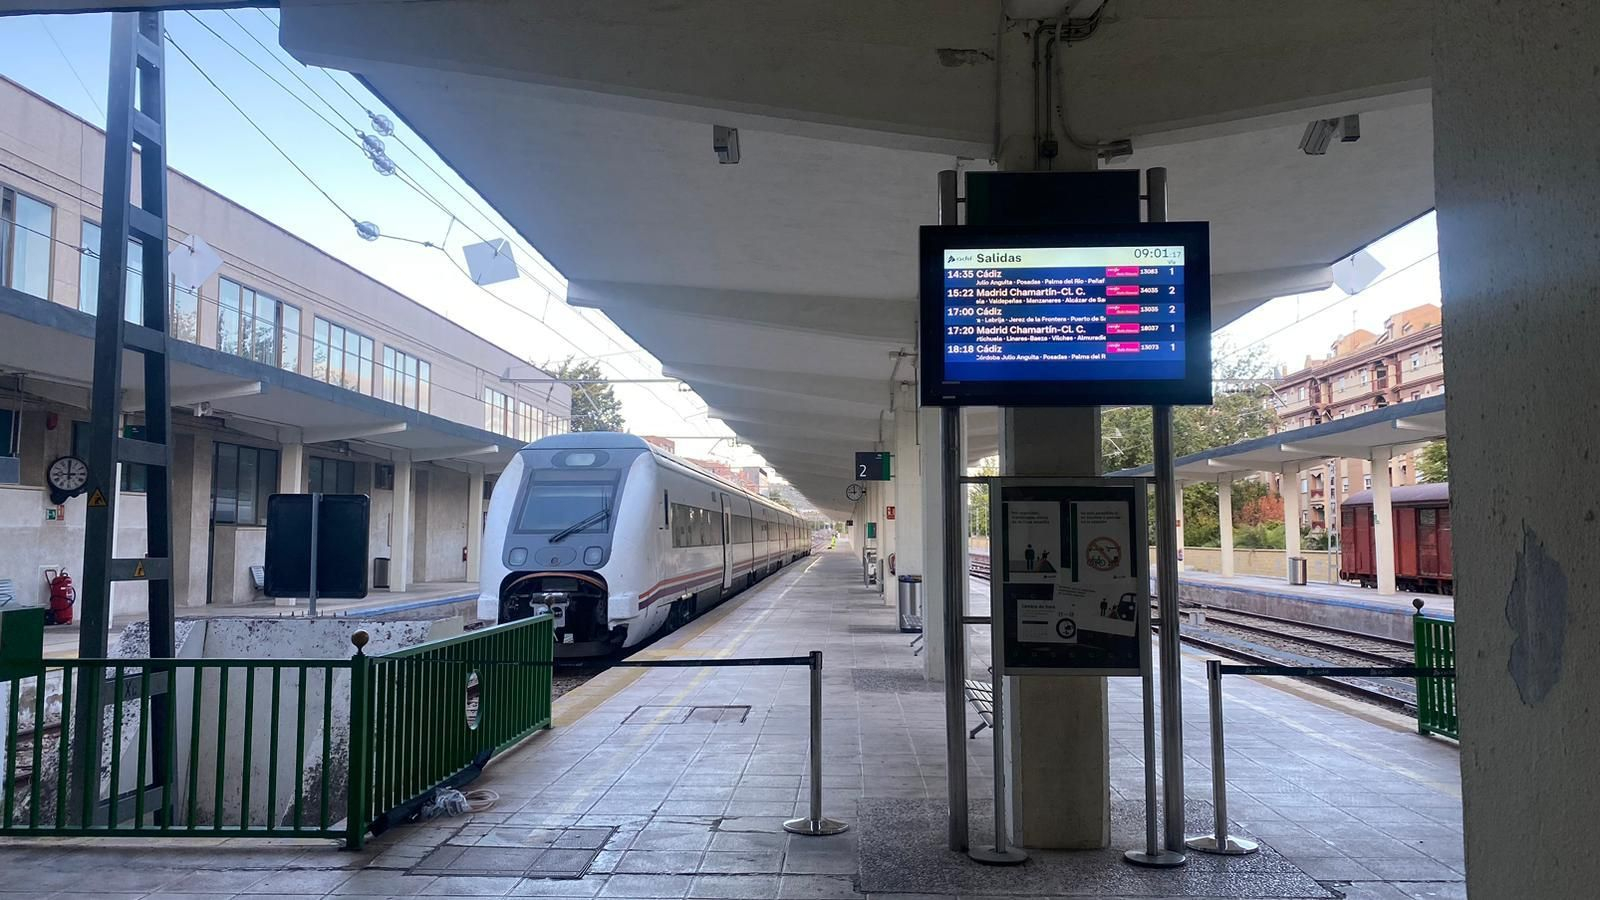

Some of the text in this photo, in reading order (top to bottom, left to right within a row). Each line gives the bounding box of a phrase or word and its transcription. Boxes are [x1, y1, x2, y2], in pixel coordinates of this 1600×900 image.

[976, 253, 1022, 263] Salidas
[976, 270, 1002, 278] Cádiz
[947, 289, 974, 297] 15:22
[976, 288, 1008, 296] Madrid
[1169, 286, 1175, 294] 2
[947, 307, 1002, 316] 17:00 Cádiz
[1169, 305, 1176, 314] 2
[947, 327, 974, 335] 17:20
[976, 326, 1008, 334] Madrid
[1076, 325, 1086, 333] C.
[1170, 324, 1175, 332] 1
[947, 344, 1002, 353] 18:18 Cádiz
[1170, 343, 1175, 351] 1
[859, 464, 867, 477] 2
